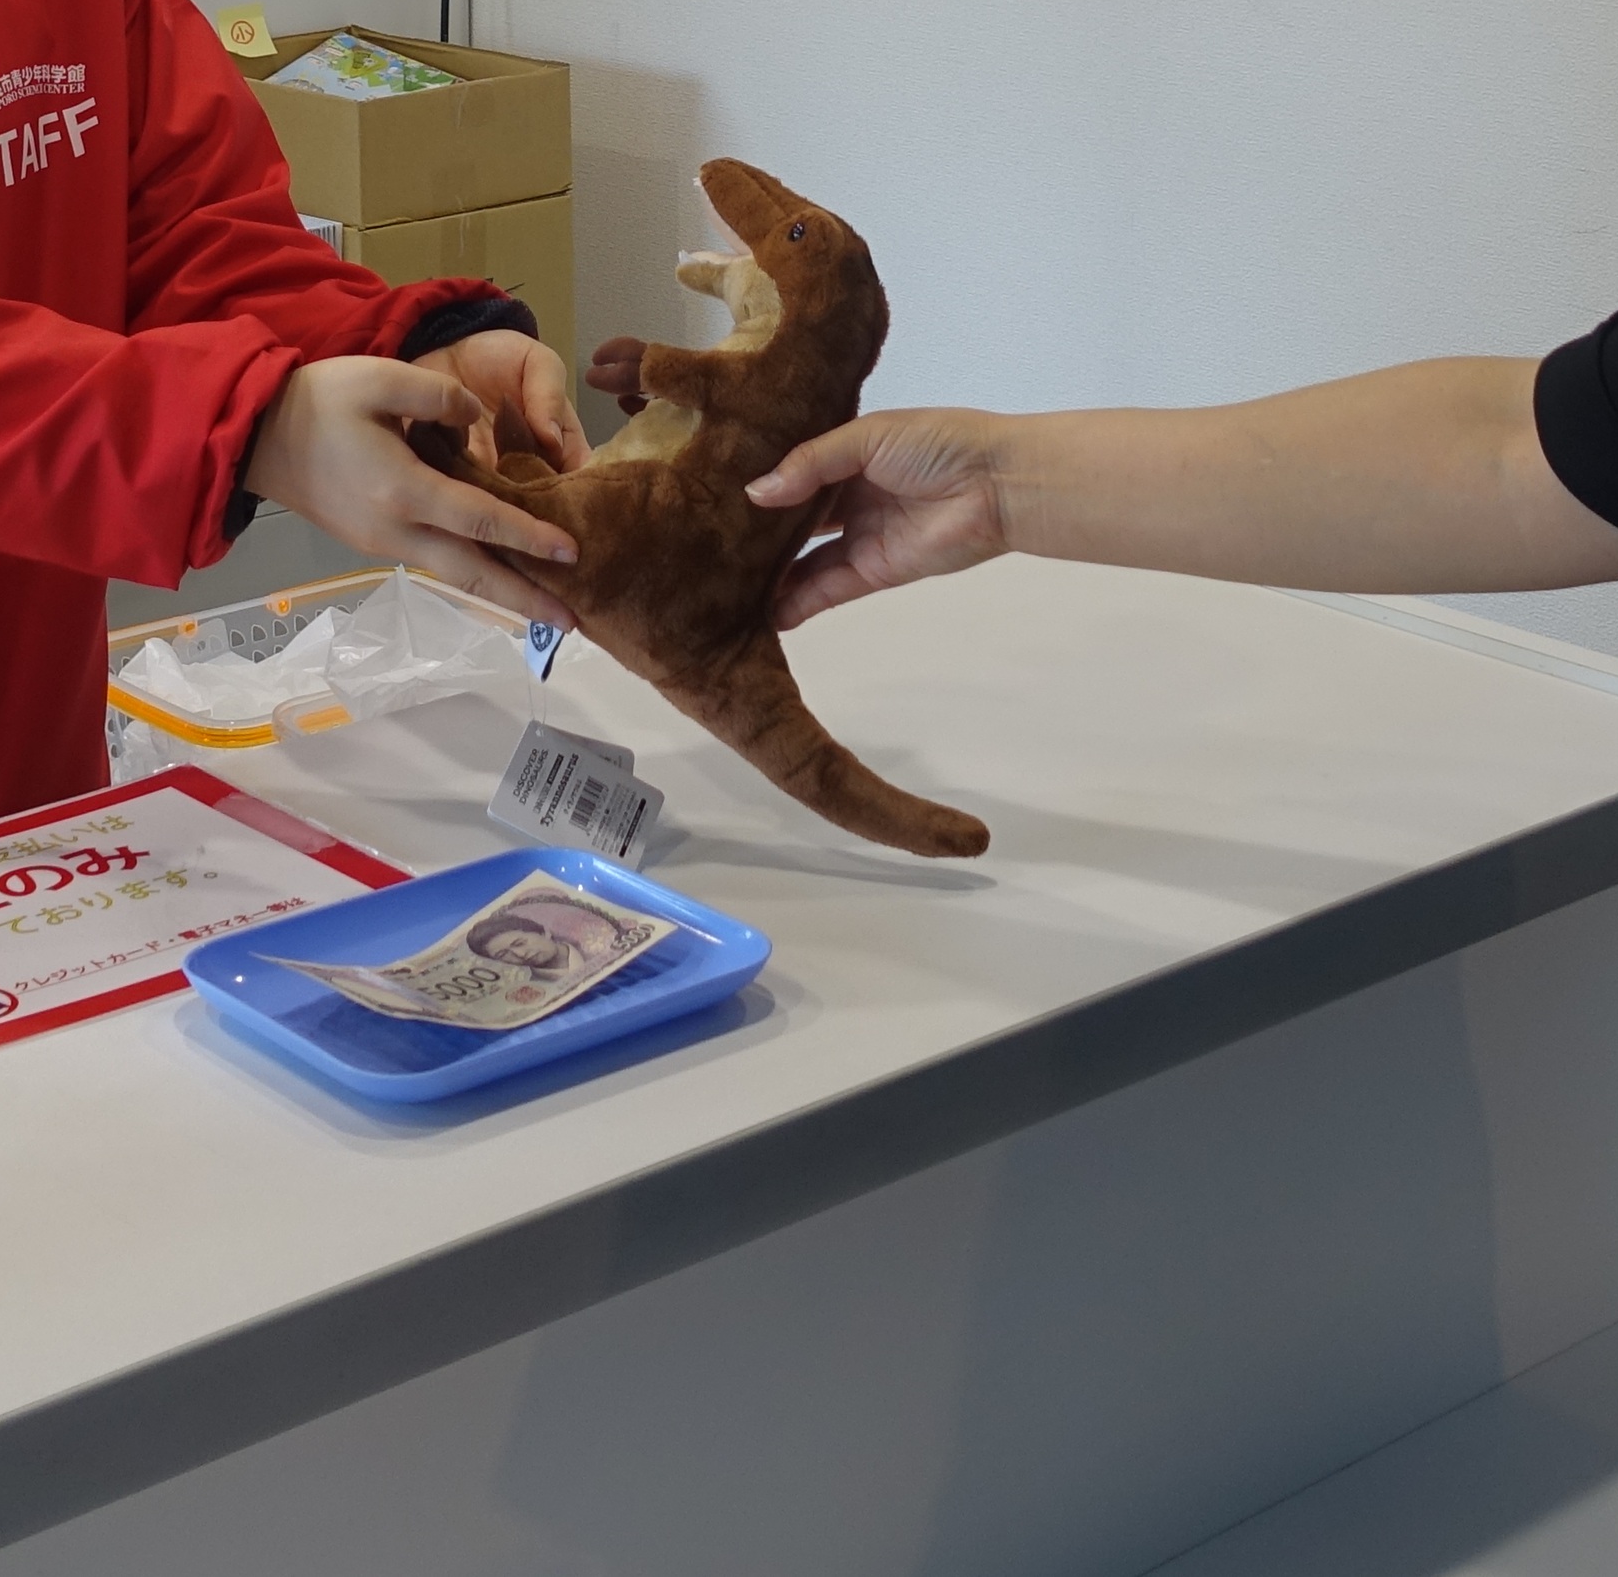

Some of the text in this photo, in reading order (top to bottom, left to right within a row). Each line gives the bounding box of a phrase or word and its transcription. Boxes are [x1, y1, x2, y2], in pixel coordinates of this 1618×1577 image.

[43, 81, 86, 96] CENTER
[512, 748, 540, 799] DISCOVER
[518, 748, 550, 806] DINOSAURS
[539, 752, 580, 828] Tyrannosaurus
[611, 923, 656, 952] 5000
